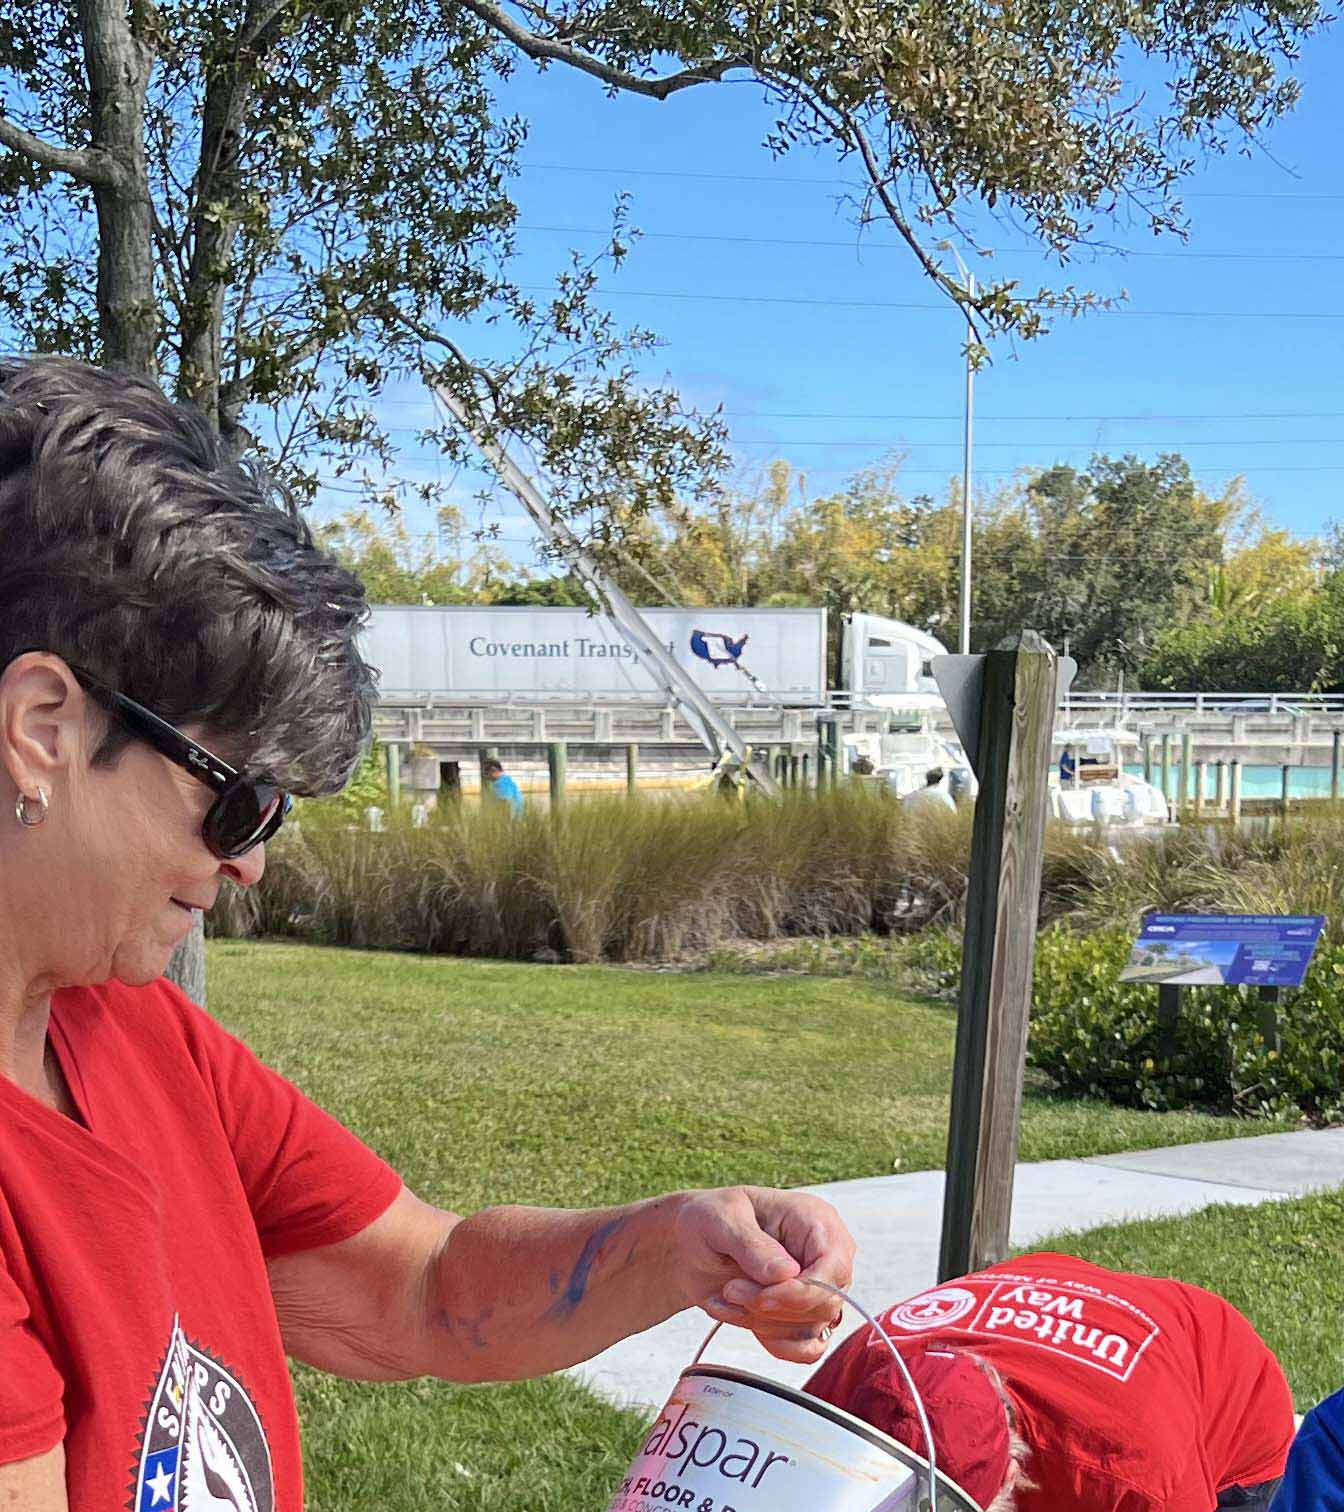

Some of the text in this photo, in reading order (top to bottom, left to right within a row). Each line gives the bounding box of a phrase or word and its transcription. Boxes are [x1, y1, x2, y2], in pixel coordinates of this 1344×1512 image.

[470, 637, 569, 658] Covenant
[999, 1285, 1085, 1320] Way
[985, 1306, 1129, 1367] United
[643, 1403, 789, 1488] alspar
[633, 1477, 696, 1509] FLOOR
